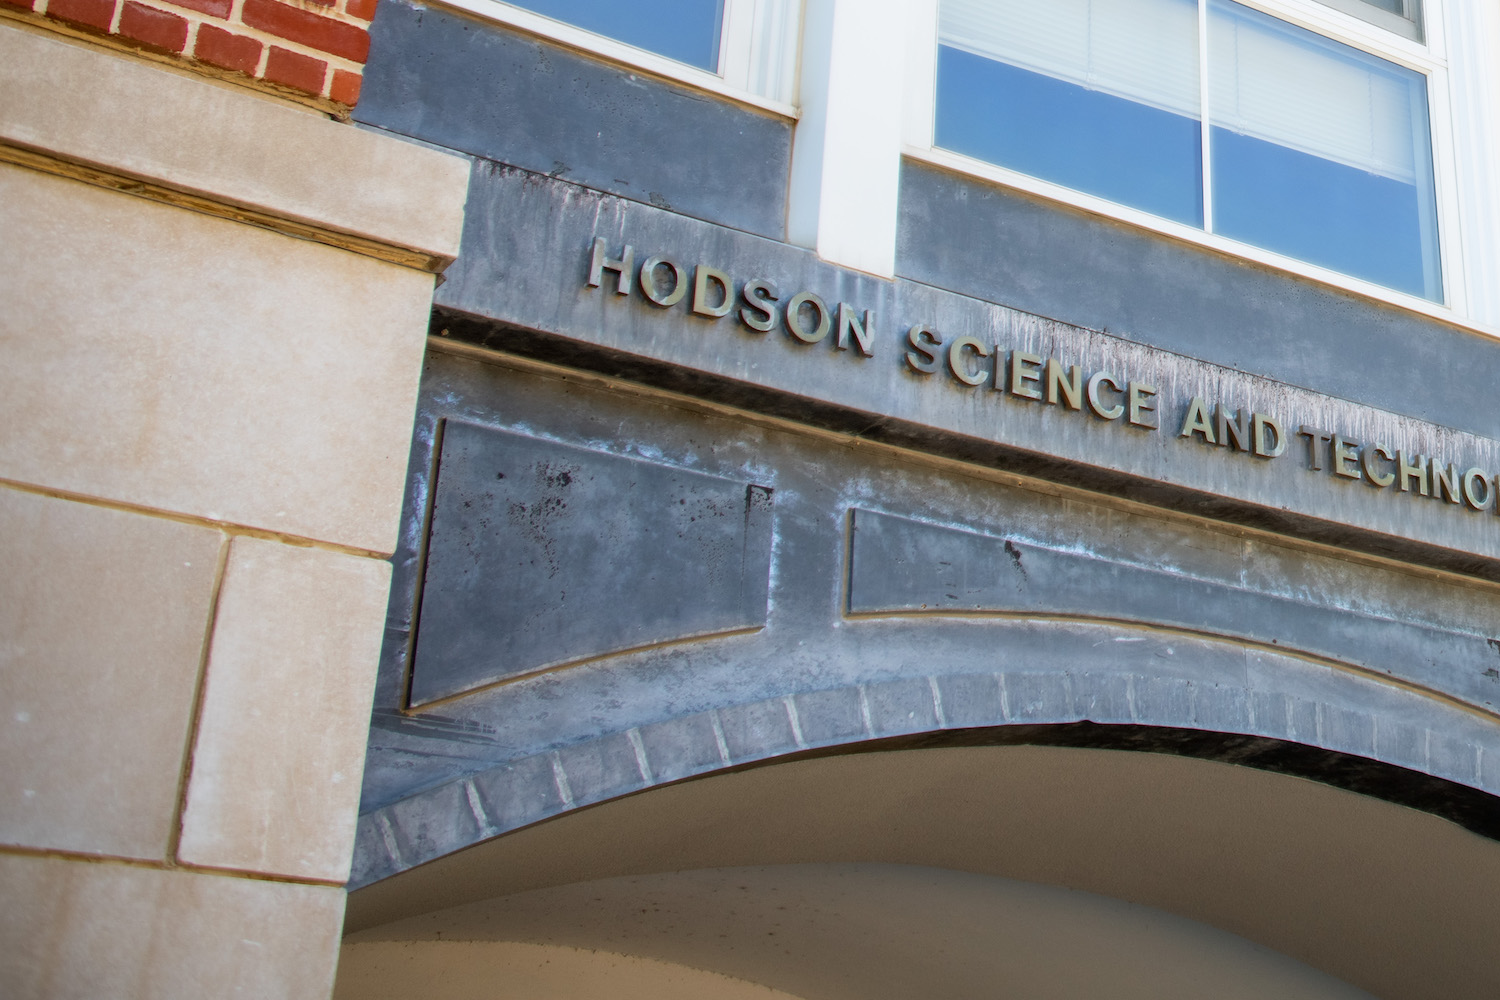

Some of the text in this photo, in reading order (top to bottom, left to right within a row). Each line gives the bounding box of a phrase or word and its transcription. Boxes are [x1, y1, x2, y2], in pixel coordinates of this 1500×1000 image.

[588, 237, 876, 358] HODSON
[905, 324, 1158, 430] SCIENCE
[1181, 397, 1285, 458] AND
